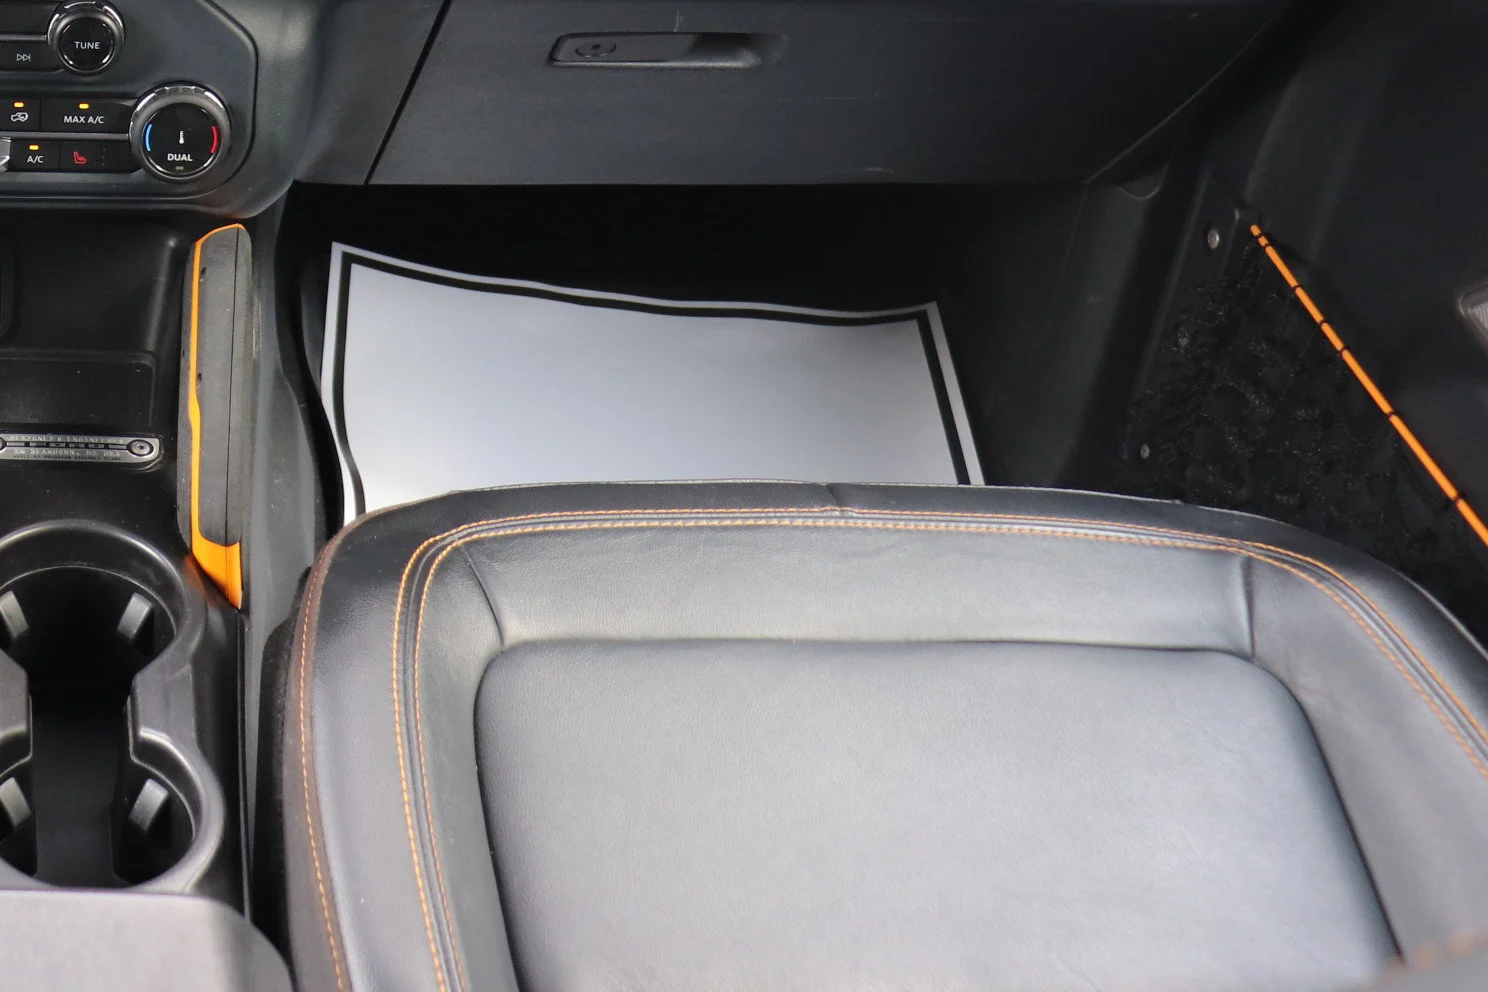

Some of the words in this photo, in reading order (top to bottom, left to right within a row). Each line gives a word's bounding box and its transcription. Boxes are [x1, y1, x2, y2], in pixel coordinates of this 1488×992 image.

[74, 41, 100, 50] TUNE
[63, 115, 87, 124] MAX
[87, 115, 105, 125] A/C
[26, 155, 44, 164] A/C
[167, 153, 193, 162] DUAL
